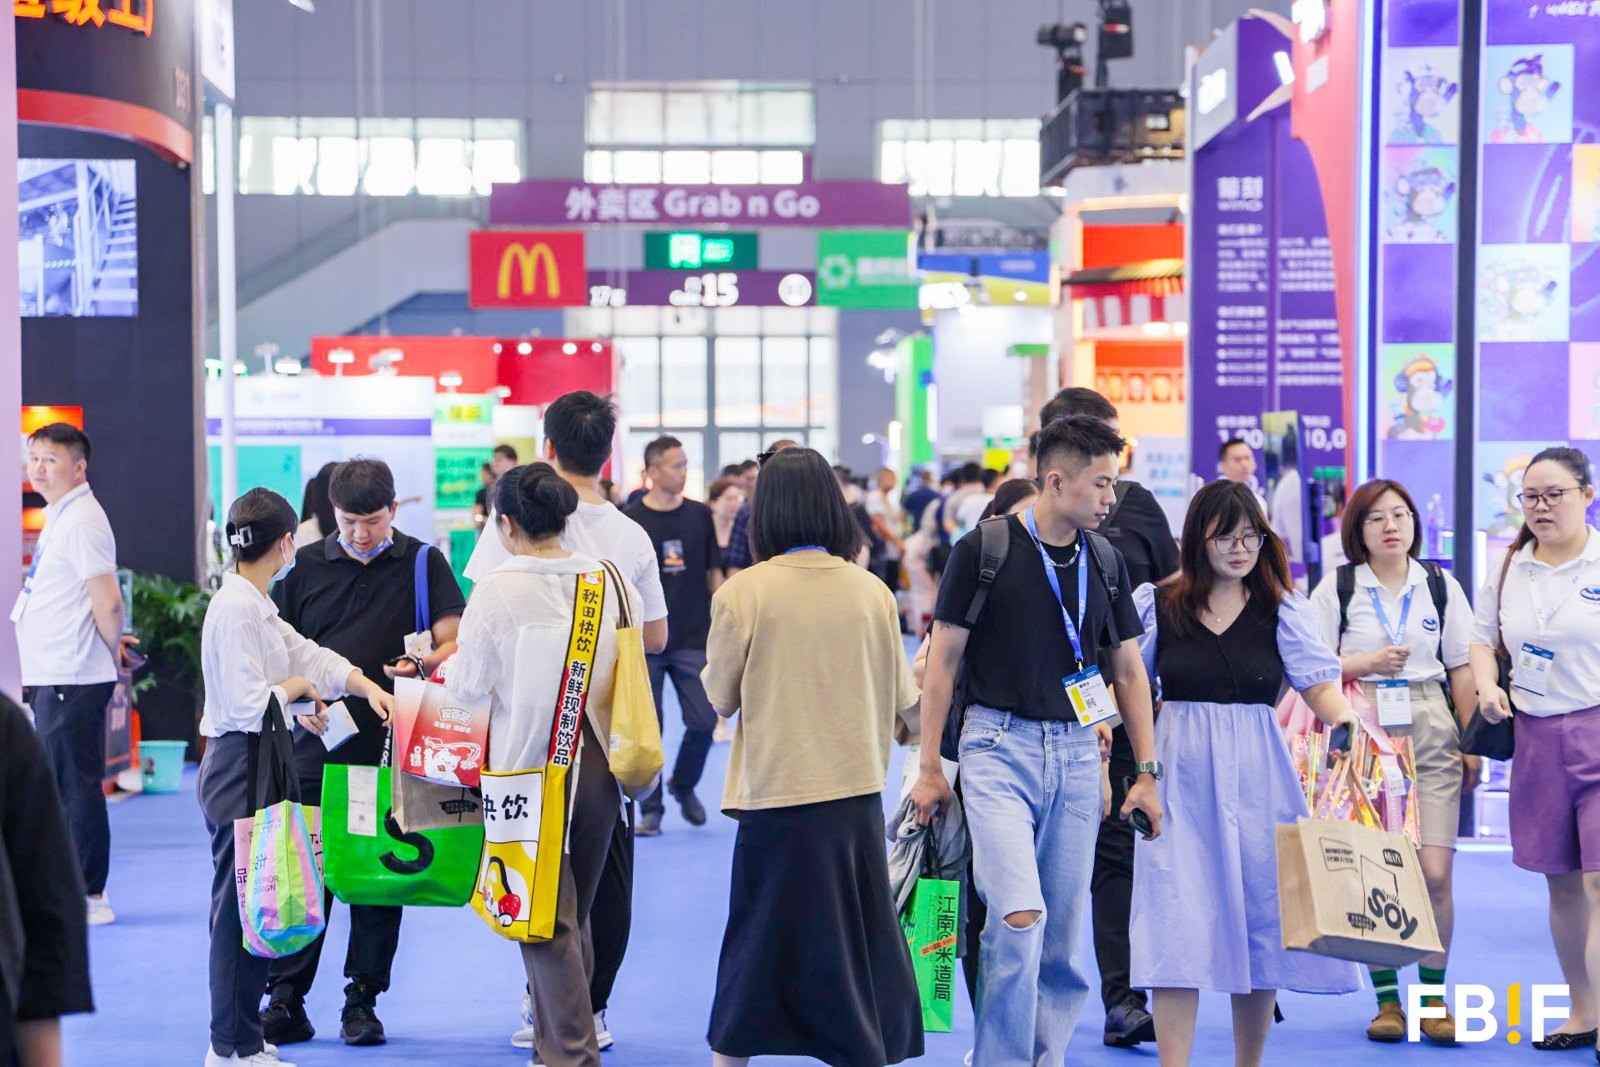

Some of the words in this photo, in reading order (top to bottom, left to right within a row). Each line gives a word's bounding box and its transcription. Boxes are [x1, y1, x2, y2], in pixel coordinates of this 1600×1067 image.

[566, 187, 660, 220] 外卖区
[664, 188, 742, 218] Grab
[748, 195, 769, 217] n
[774, 189, 820, 218] Go
[577, 589, 599, 653] 秋田快饮
[553, 660, 587, 766] 新鲜现制饮品
